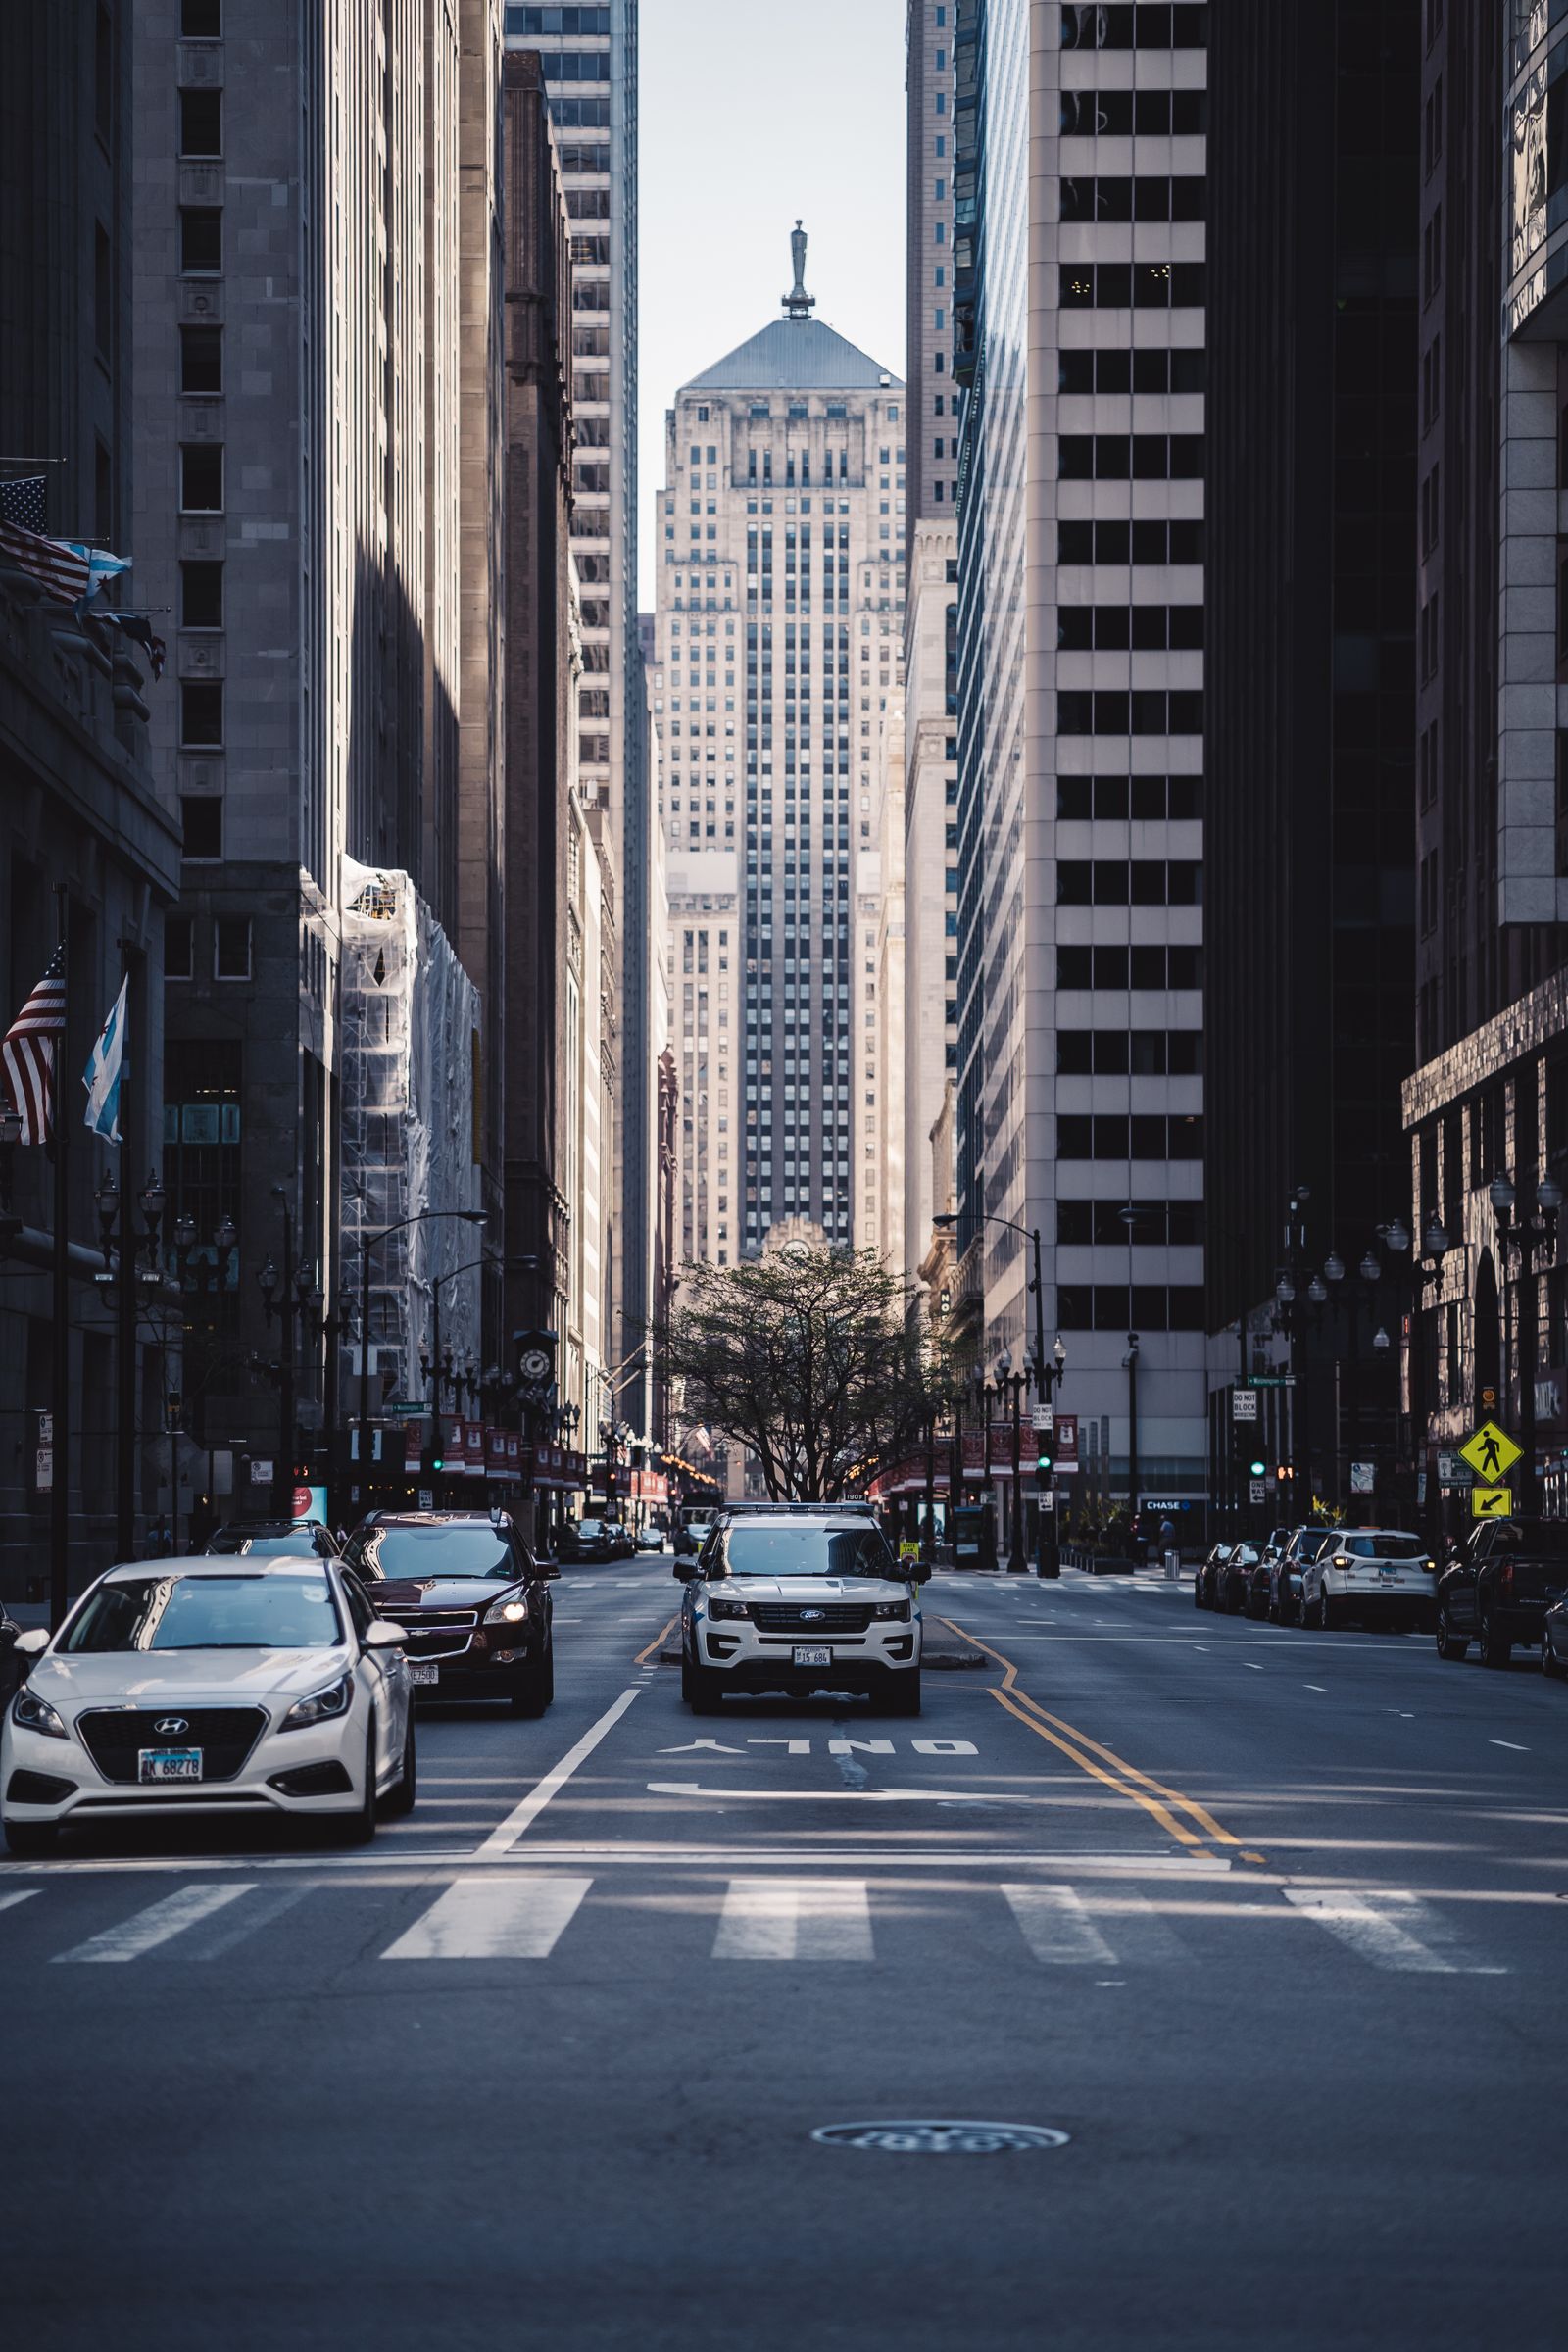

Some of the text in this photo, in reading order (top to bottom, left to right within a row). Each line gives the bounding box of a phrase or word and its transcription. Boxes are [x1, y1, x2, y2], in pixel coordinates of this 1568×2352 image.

[1146, 1500, 1181, 1510] CHASE
[656, 1738, 979, 1755] ONLY
[163, 1758, 199, 1775] 68278
